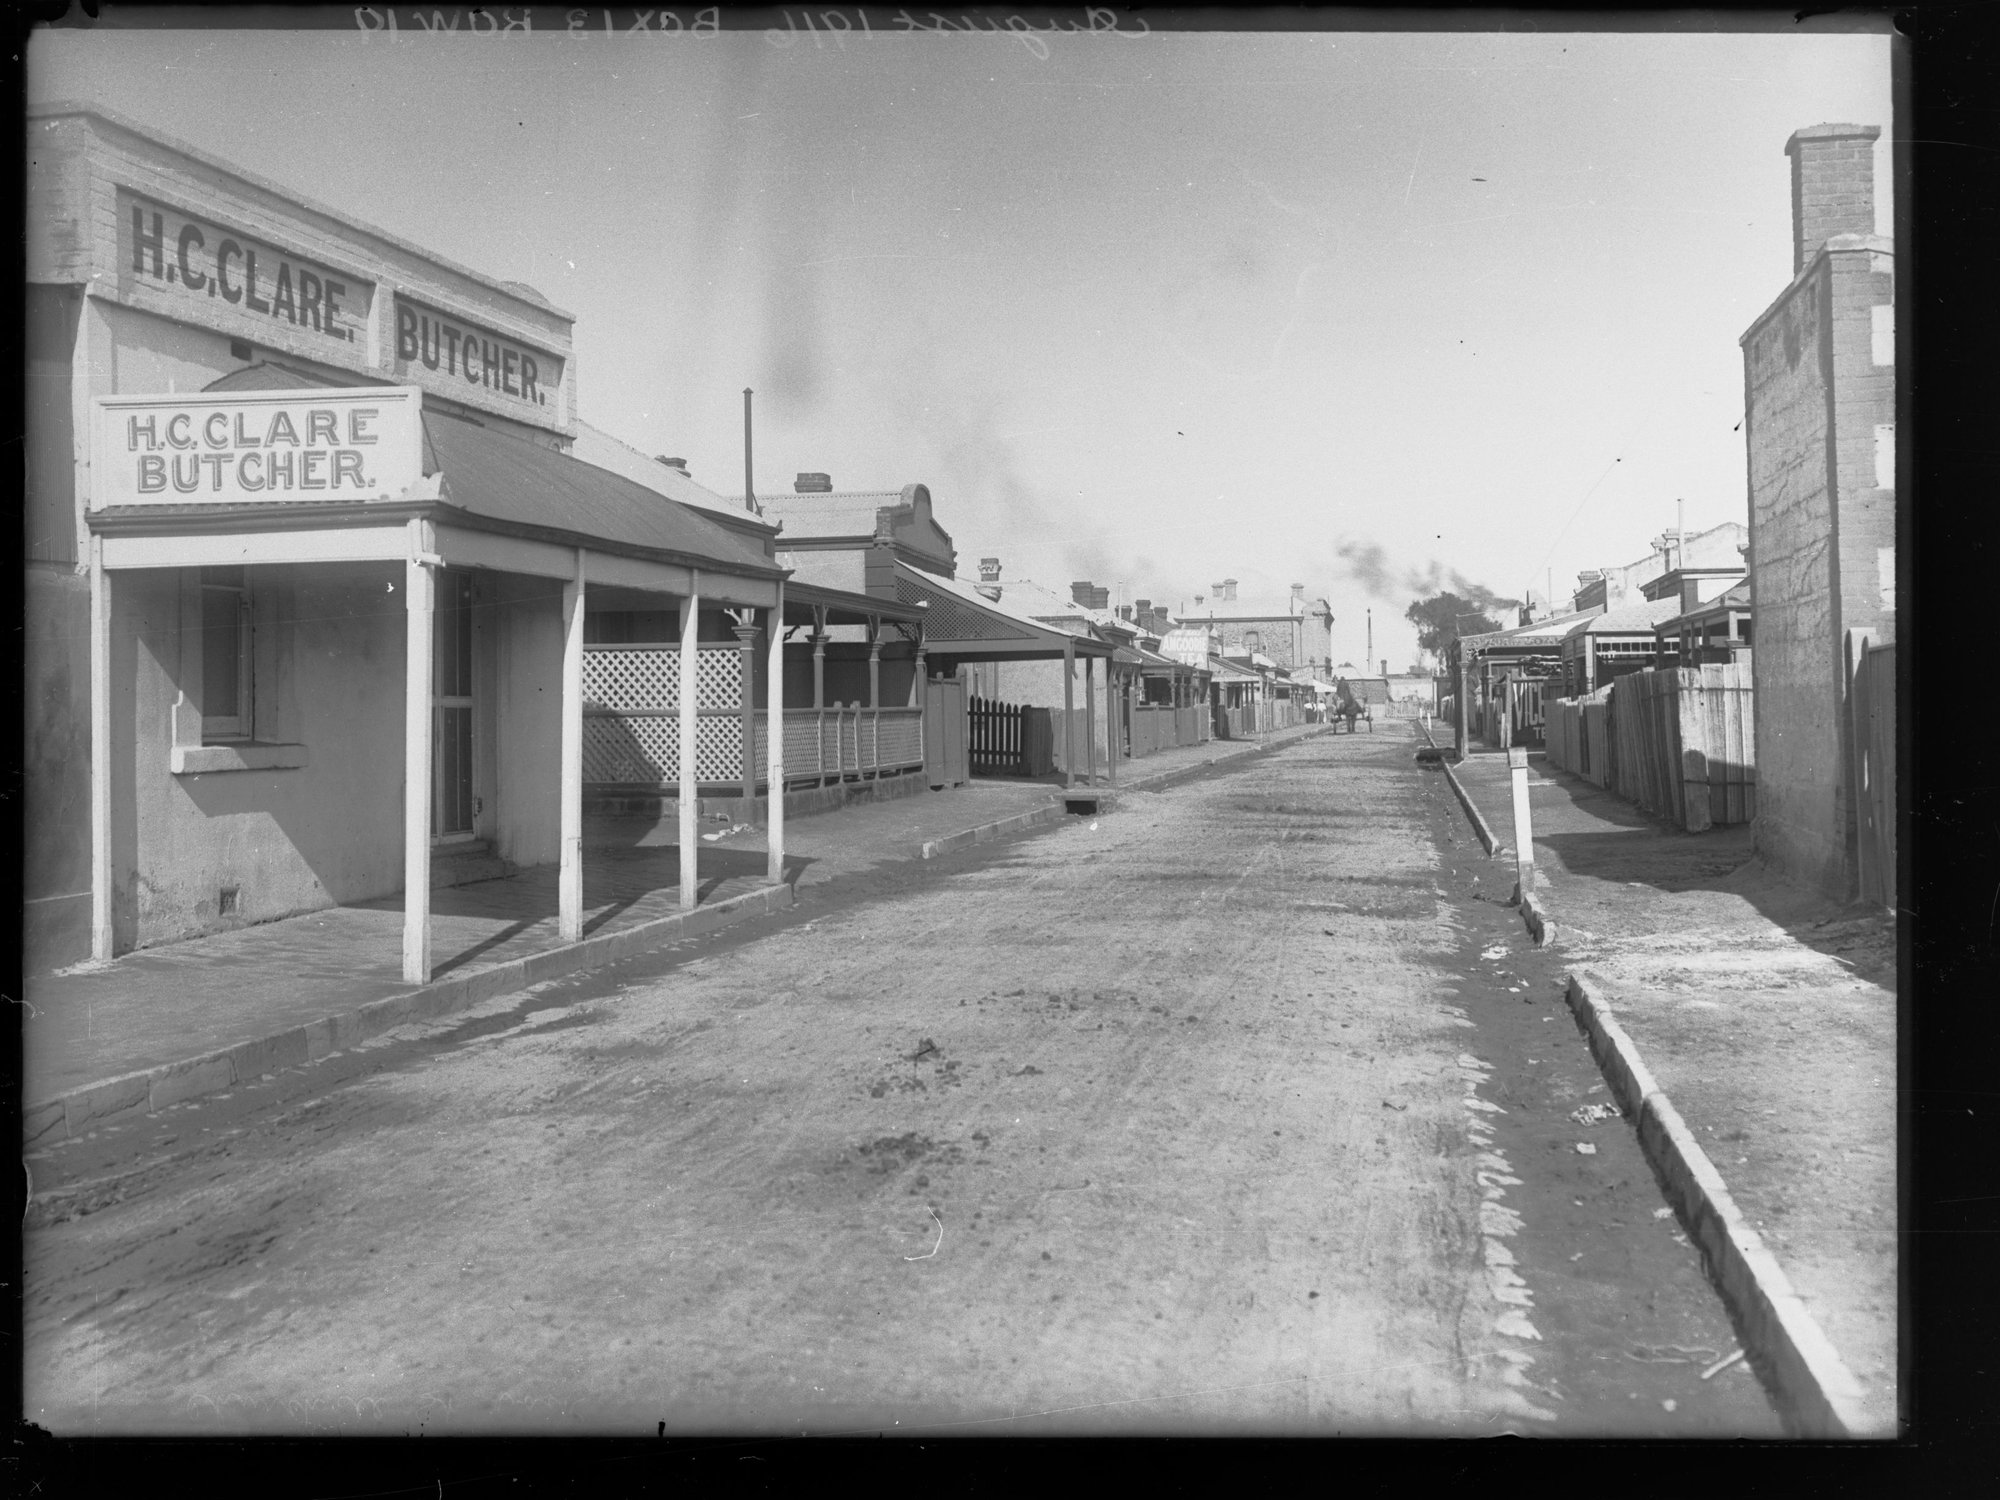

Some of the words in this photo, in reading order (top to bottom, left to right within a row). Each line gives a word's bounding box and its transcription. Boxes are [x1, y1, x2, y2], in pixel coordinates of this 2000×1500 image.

[397, 303, 546, 406] BUTCHER.
[137, 449, 377, 494] BUTCHER.
[1178, 652, 1205, 665] TEA
